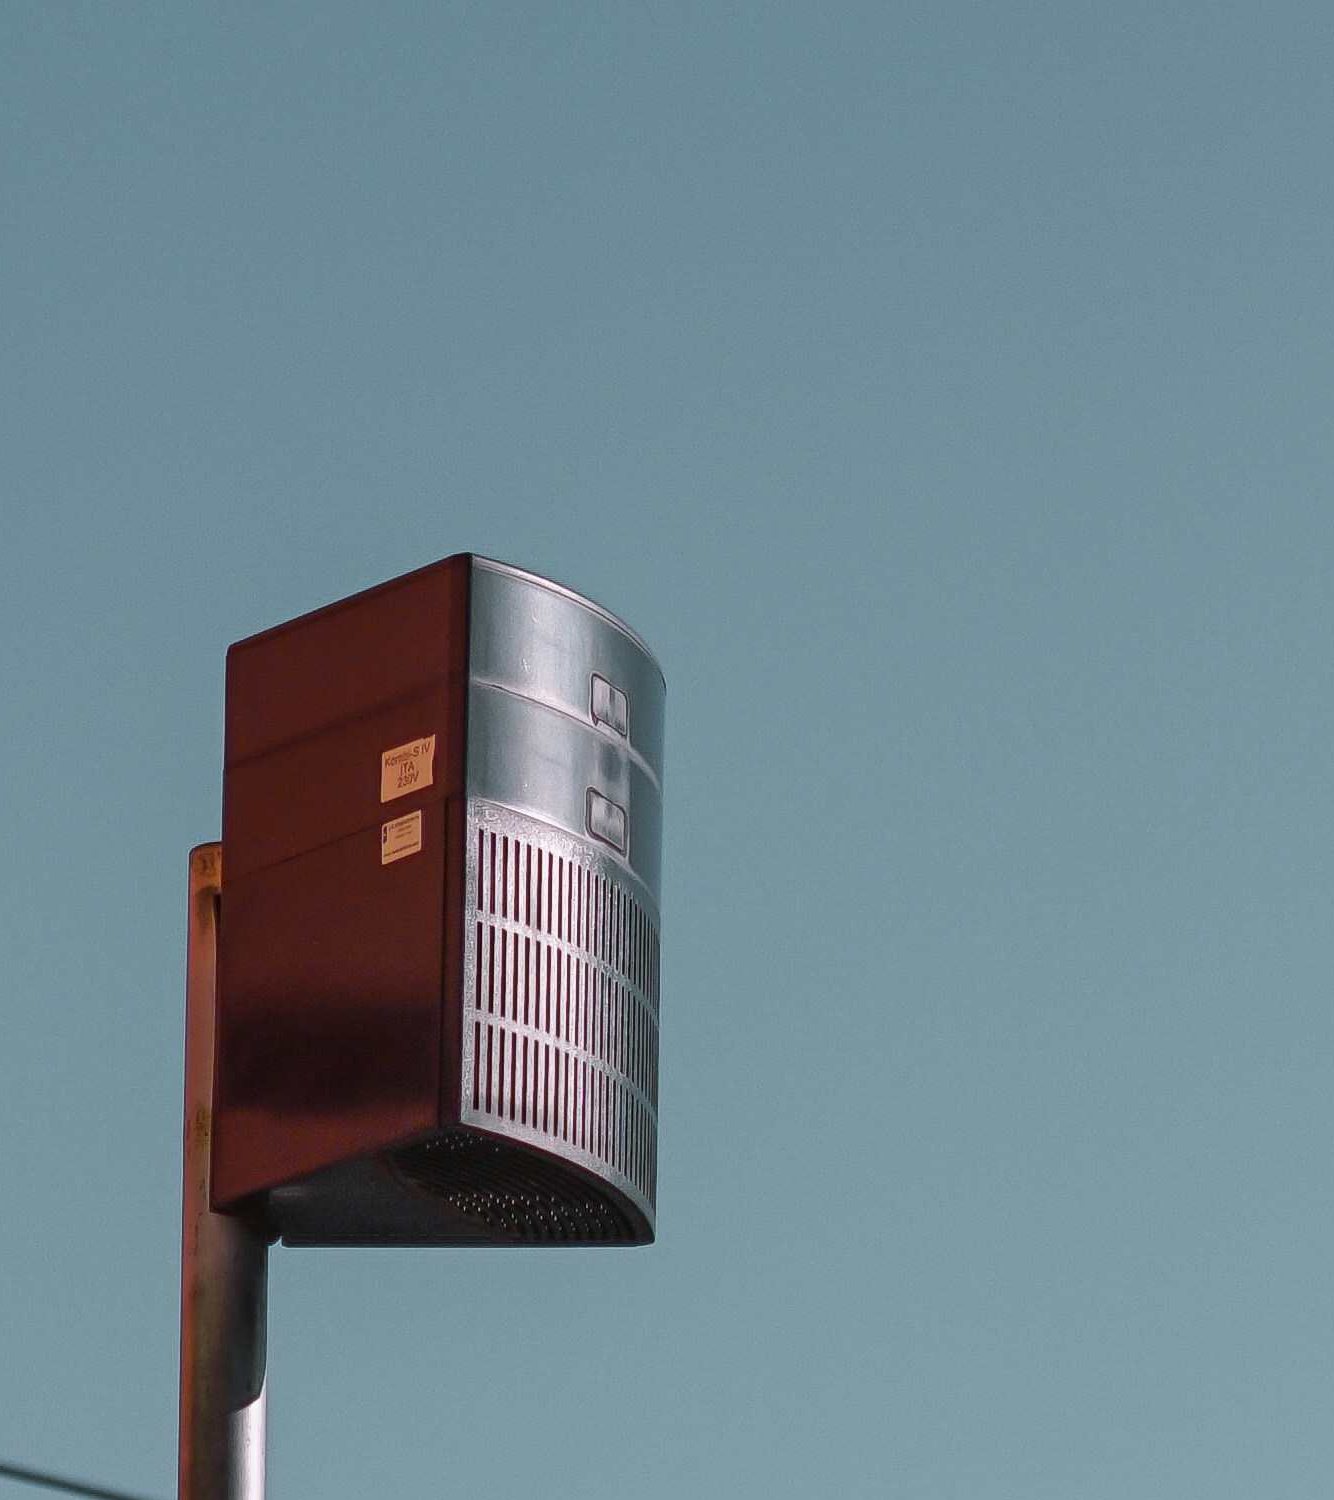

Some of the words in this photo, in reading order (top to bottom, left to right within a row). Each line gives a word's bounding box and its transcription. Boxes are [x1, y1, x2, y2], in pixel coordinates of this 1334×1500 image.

[422, 742, 431, 755] IV
[400, 761, 415, 776] ITA
[397, 771, 419, 788] 230V
